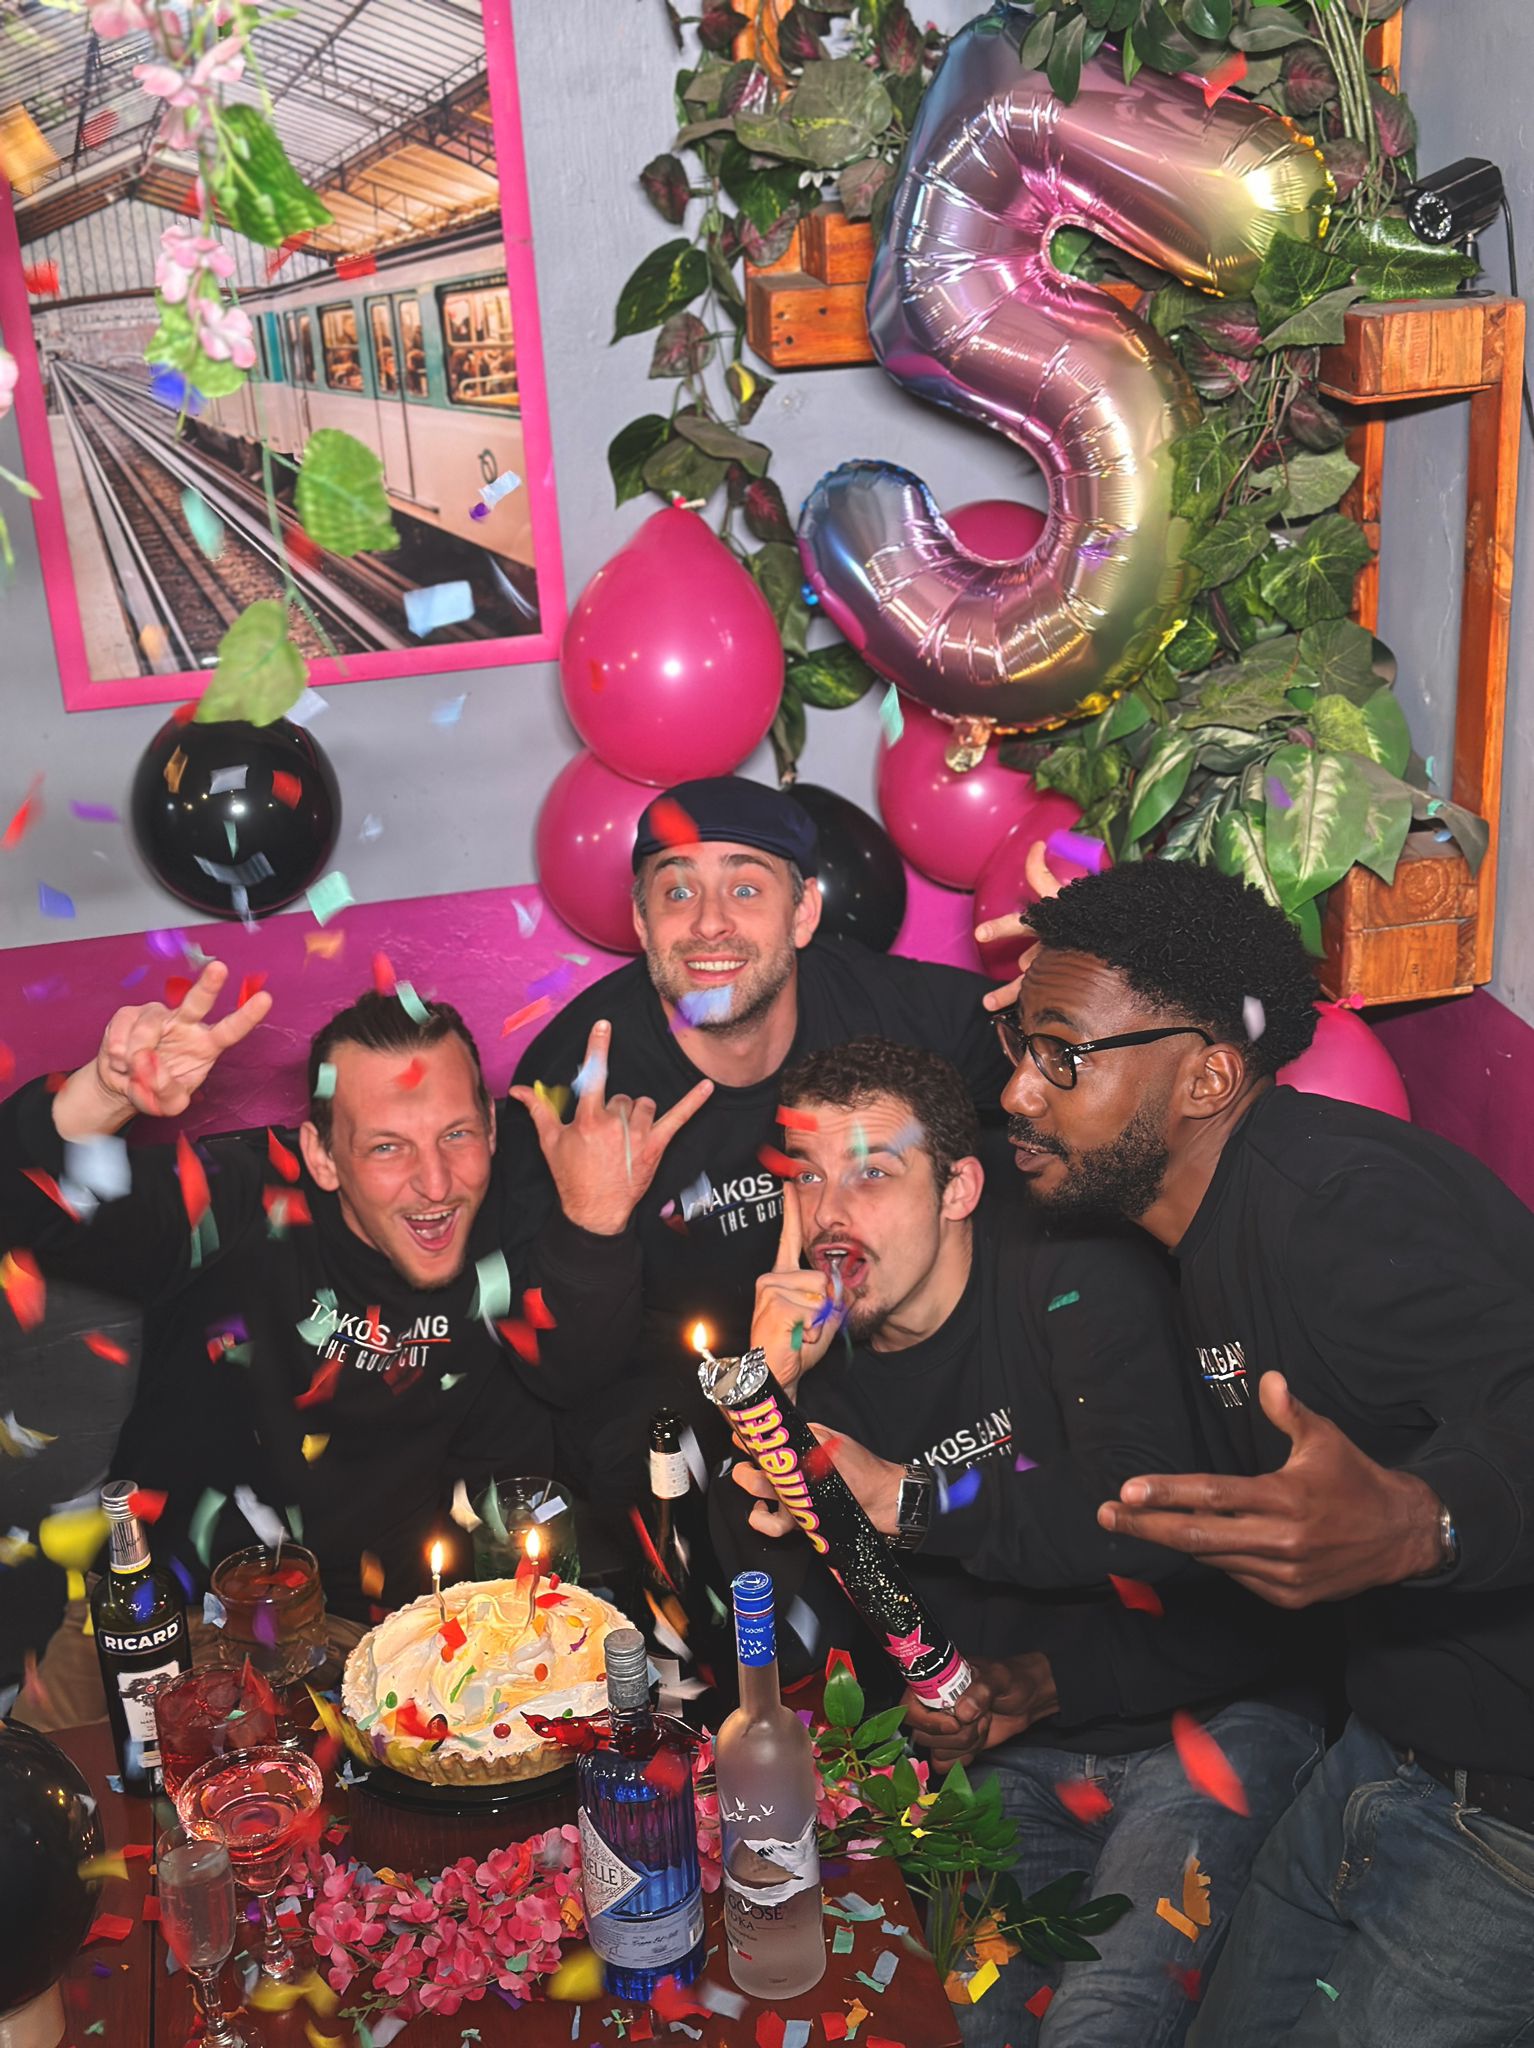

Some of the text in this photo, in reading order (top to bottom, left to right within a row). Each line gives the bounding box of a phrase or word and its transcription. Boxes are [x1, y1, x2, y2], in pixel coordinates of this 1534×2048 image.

[799, 2, 1337, 735] 5
[719, 1206, 749, 1237] THE
[312, 1298, 391, 1346] TAKOS
[104, 1622, 179, 1651] RICARD
[728, 1893, 784, 1921] GOOSE
